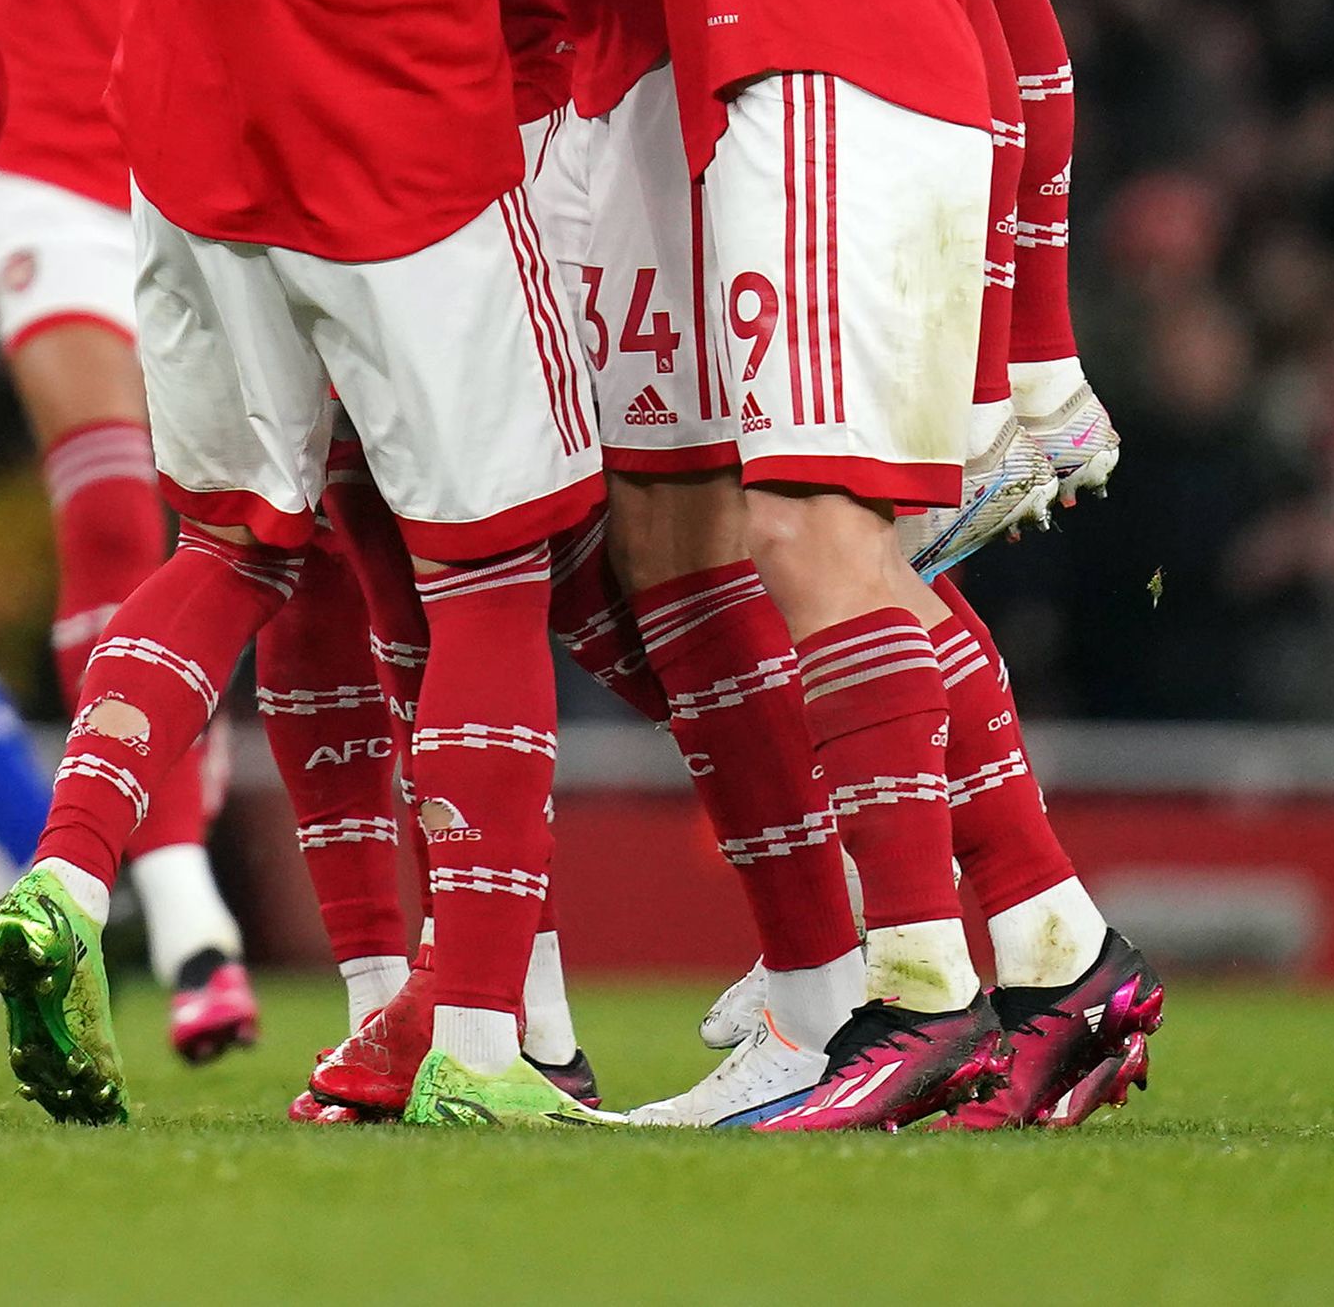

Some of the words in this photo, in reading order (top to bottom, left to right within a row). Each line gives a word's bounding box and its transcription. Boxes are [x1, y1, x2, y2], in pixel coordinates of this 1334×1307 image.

[581, 266, 682, 374] 34
[721, 271, 780, 382] 9
[624, 410, 679, 425] adidas
[389, 696, 419, 723] AF
[305, 736, 394, 770] AFC
